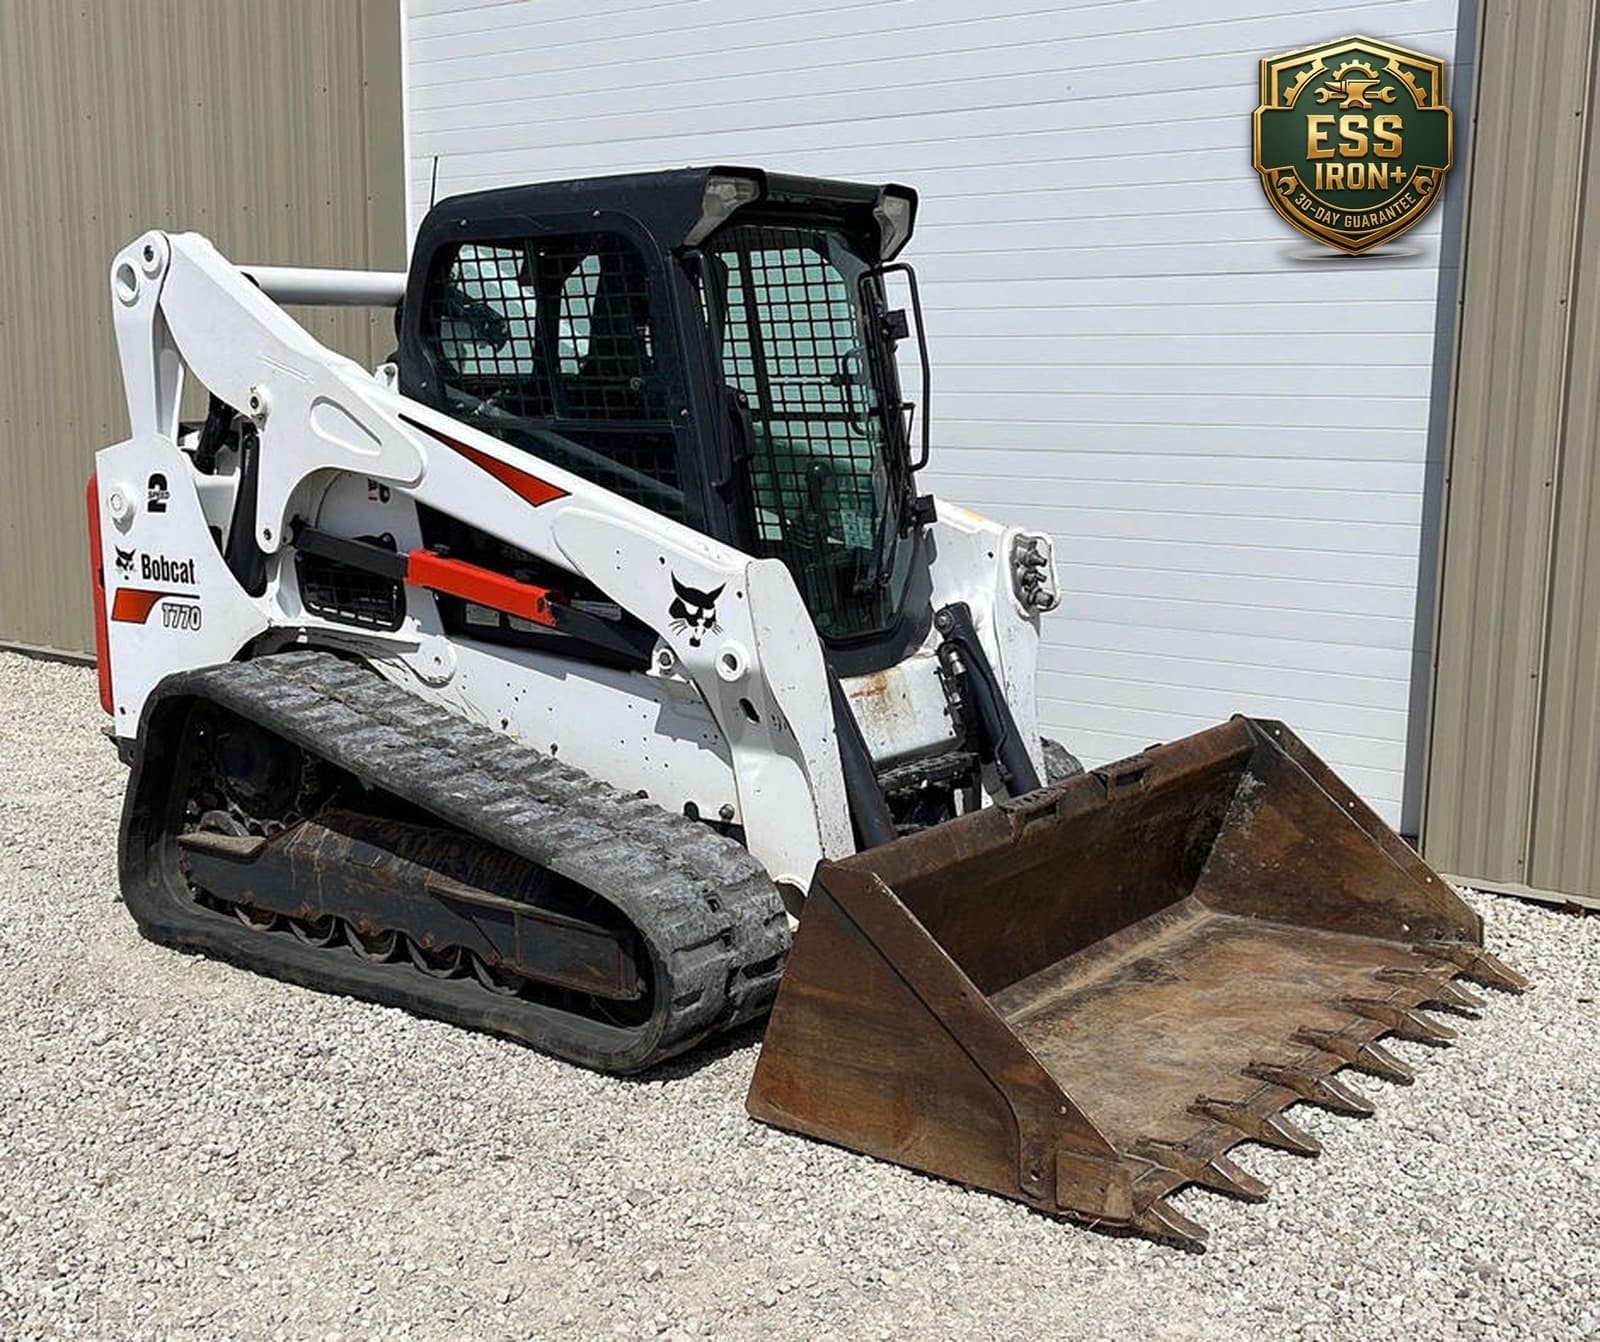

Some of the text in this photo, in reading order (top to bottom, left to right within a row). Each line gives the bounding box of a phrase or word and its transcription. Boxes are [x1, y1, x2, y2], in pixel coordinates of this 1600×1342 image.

[148, 473, 168, 512] 2
[141, 554, 195, 585] Bobcat
[161, 603, 202, 631] T770
